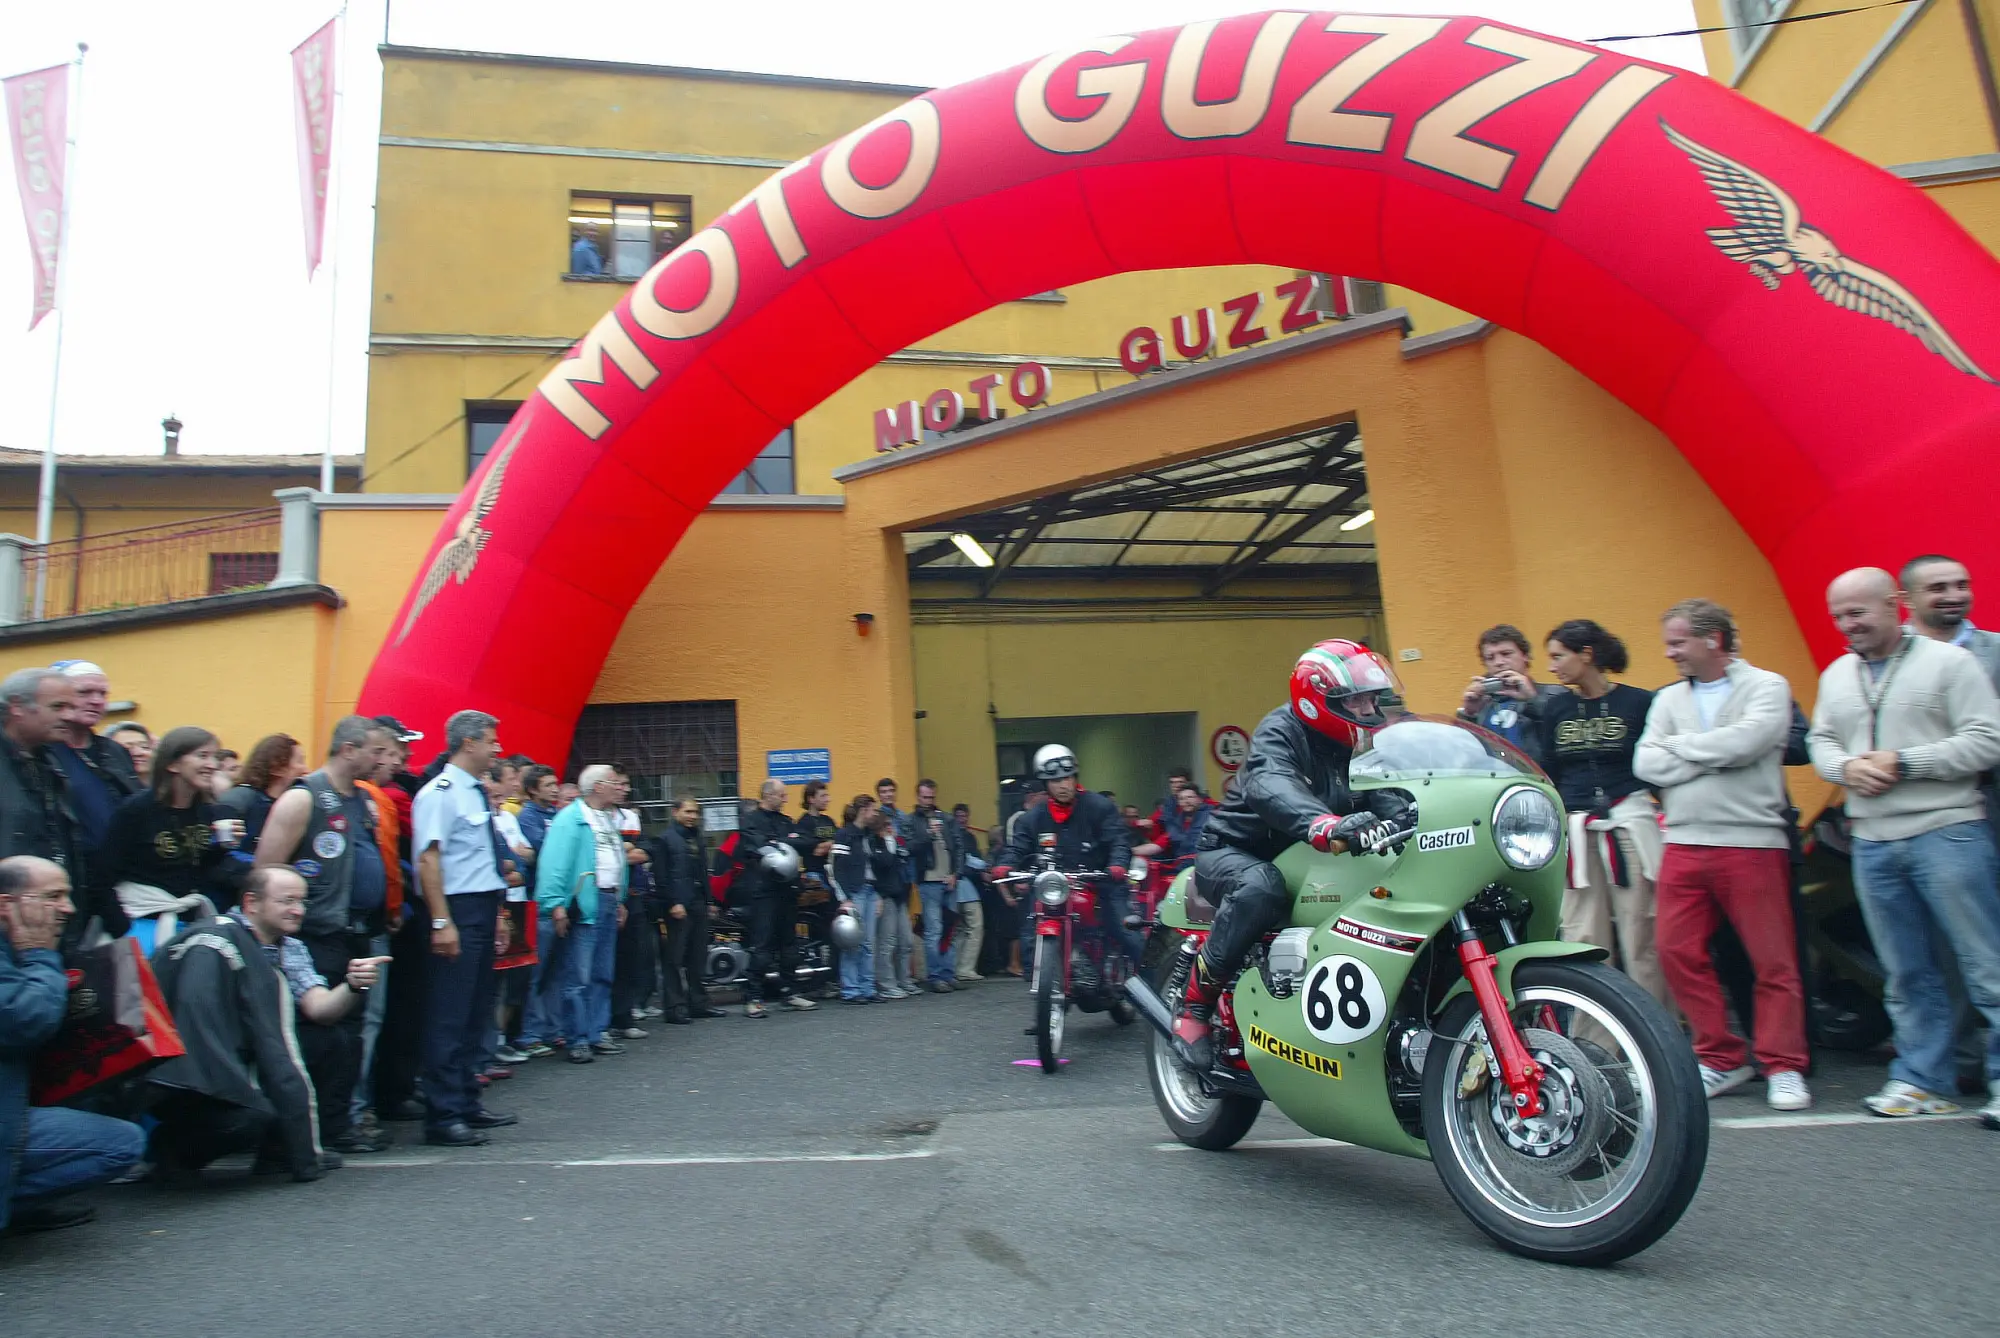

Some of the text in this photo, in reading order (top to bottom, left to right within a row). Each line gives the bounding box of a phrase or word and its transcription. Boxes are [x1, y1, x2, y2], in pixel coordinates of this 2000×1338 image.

[537, 99, 940, 441] MOTO
[1015, 11, 1676, 212] GUZZI
[874, 275, 1356, 452] MOTO GUZZI
[1420, 828, 1470, 850] Castrol
[1336, 921, 1386, 943] MOTO GUZZI
[1307, 962, 1371, 1031] 68
[1250, 1026, 1339, 1077] MICHELIN
